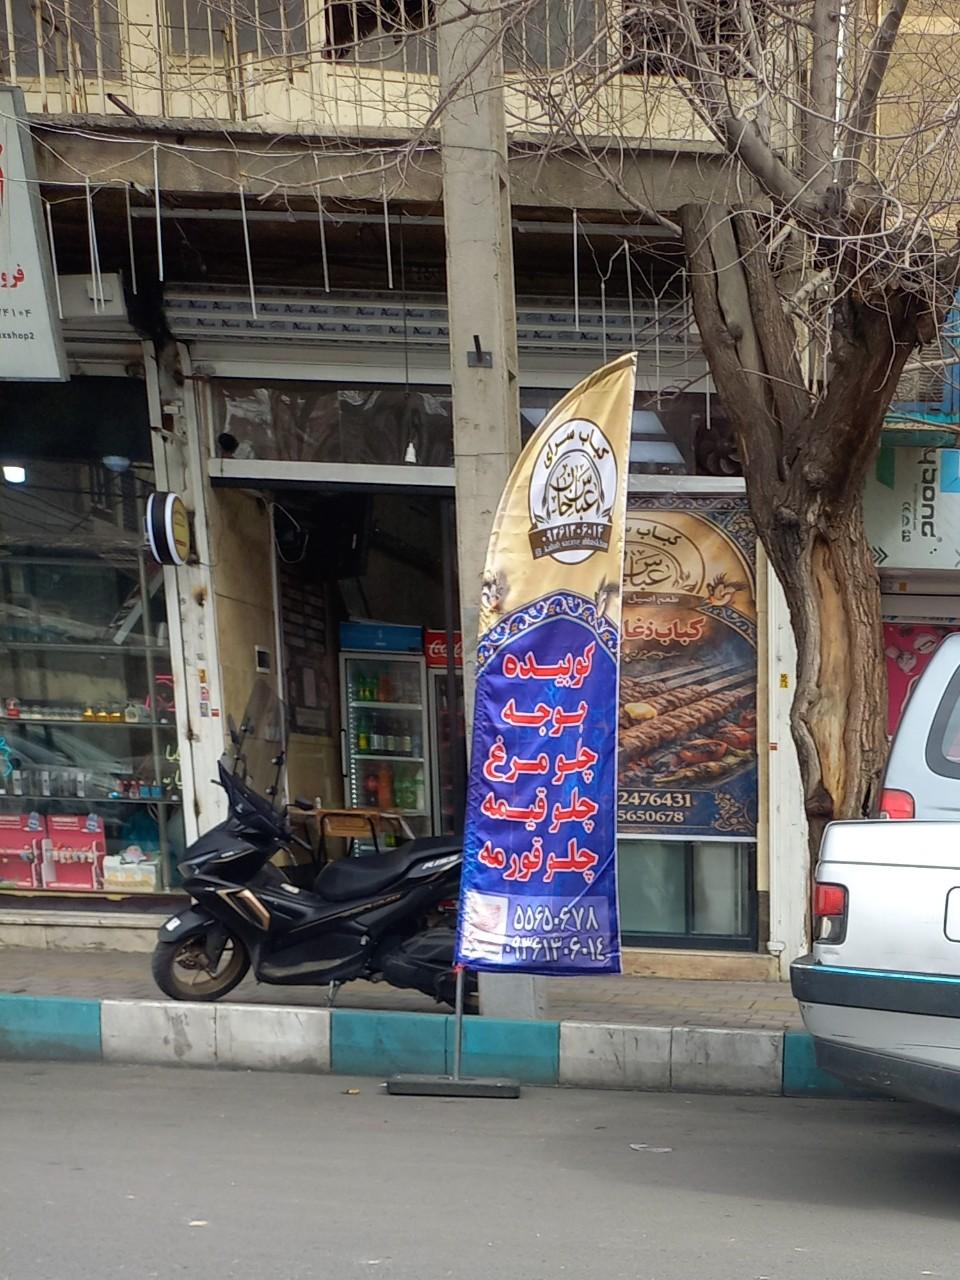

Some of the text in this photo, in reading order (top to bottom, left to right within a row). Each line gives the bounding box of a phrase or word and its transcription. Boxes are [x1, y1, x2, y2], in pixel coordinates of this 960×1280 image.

[0, 331, 35, 341] xshop2
[636, 525, 682, 546] کباب
[654, 617, 706, 645] کباب
[503, 641, 596, 688] کوبیده
[483, 735, 549, 783] مرغ
[481, 787, 598, 833] چلو قیمه
[618, 791, 692, 807] 2476431
[617, 809, 684, 823] 5650678
[478, 837, 598, 884] چلو قورمه
[513, 904, 599, 931] ۵۵۶۵۰۶۷۸
